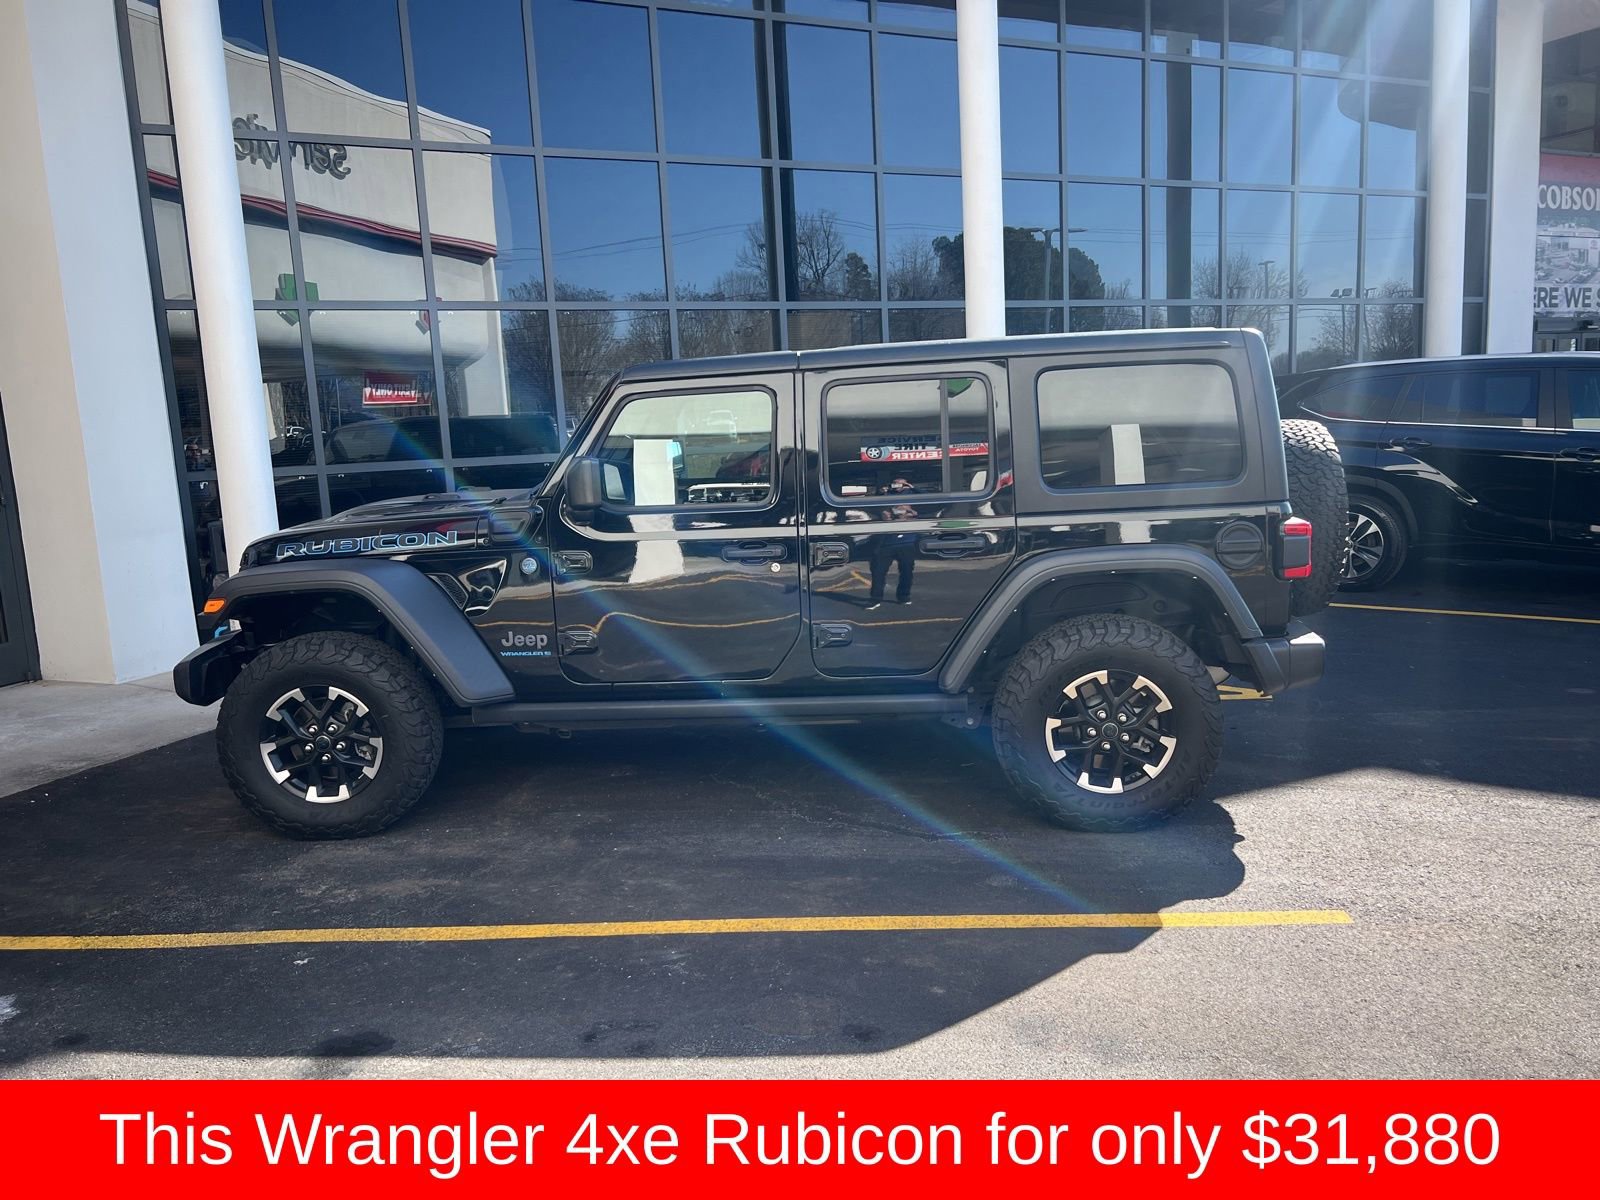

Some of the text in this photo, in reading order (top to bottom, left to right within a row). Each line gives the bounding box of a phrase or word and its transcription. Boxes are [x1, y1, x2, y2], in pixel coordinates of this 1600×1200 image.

[1538, 184, 1600, 211] COBSO
[1564, 287, 1592, 308] WE
[276, 530, 458, 558] RUBICON
[501, 631, 548, 650] Jeep
